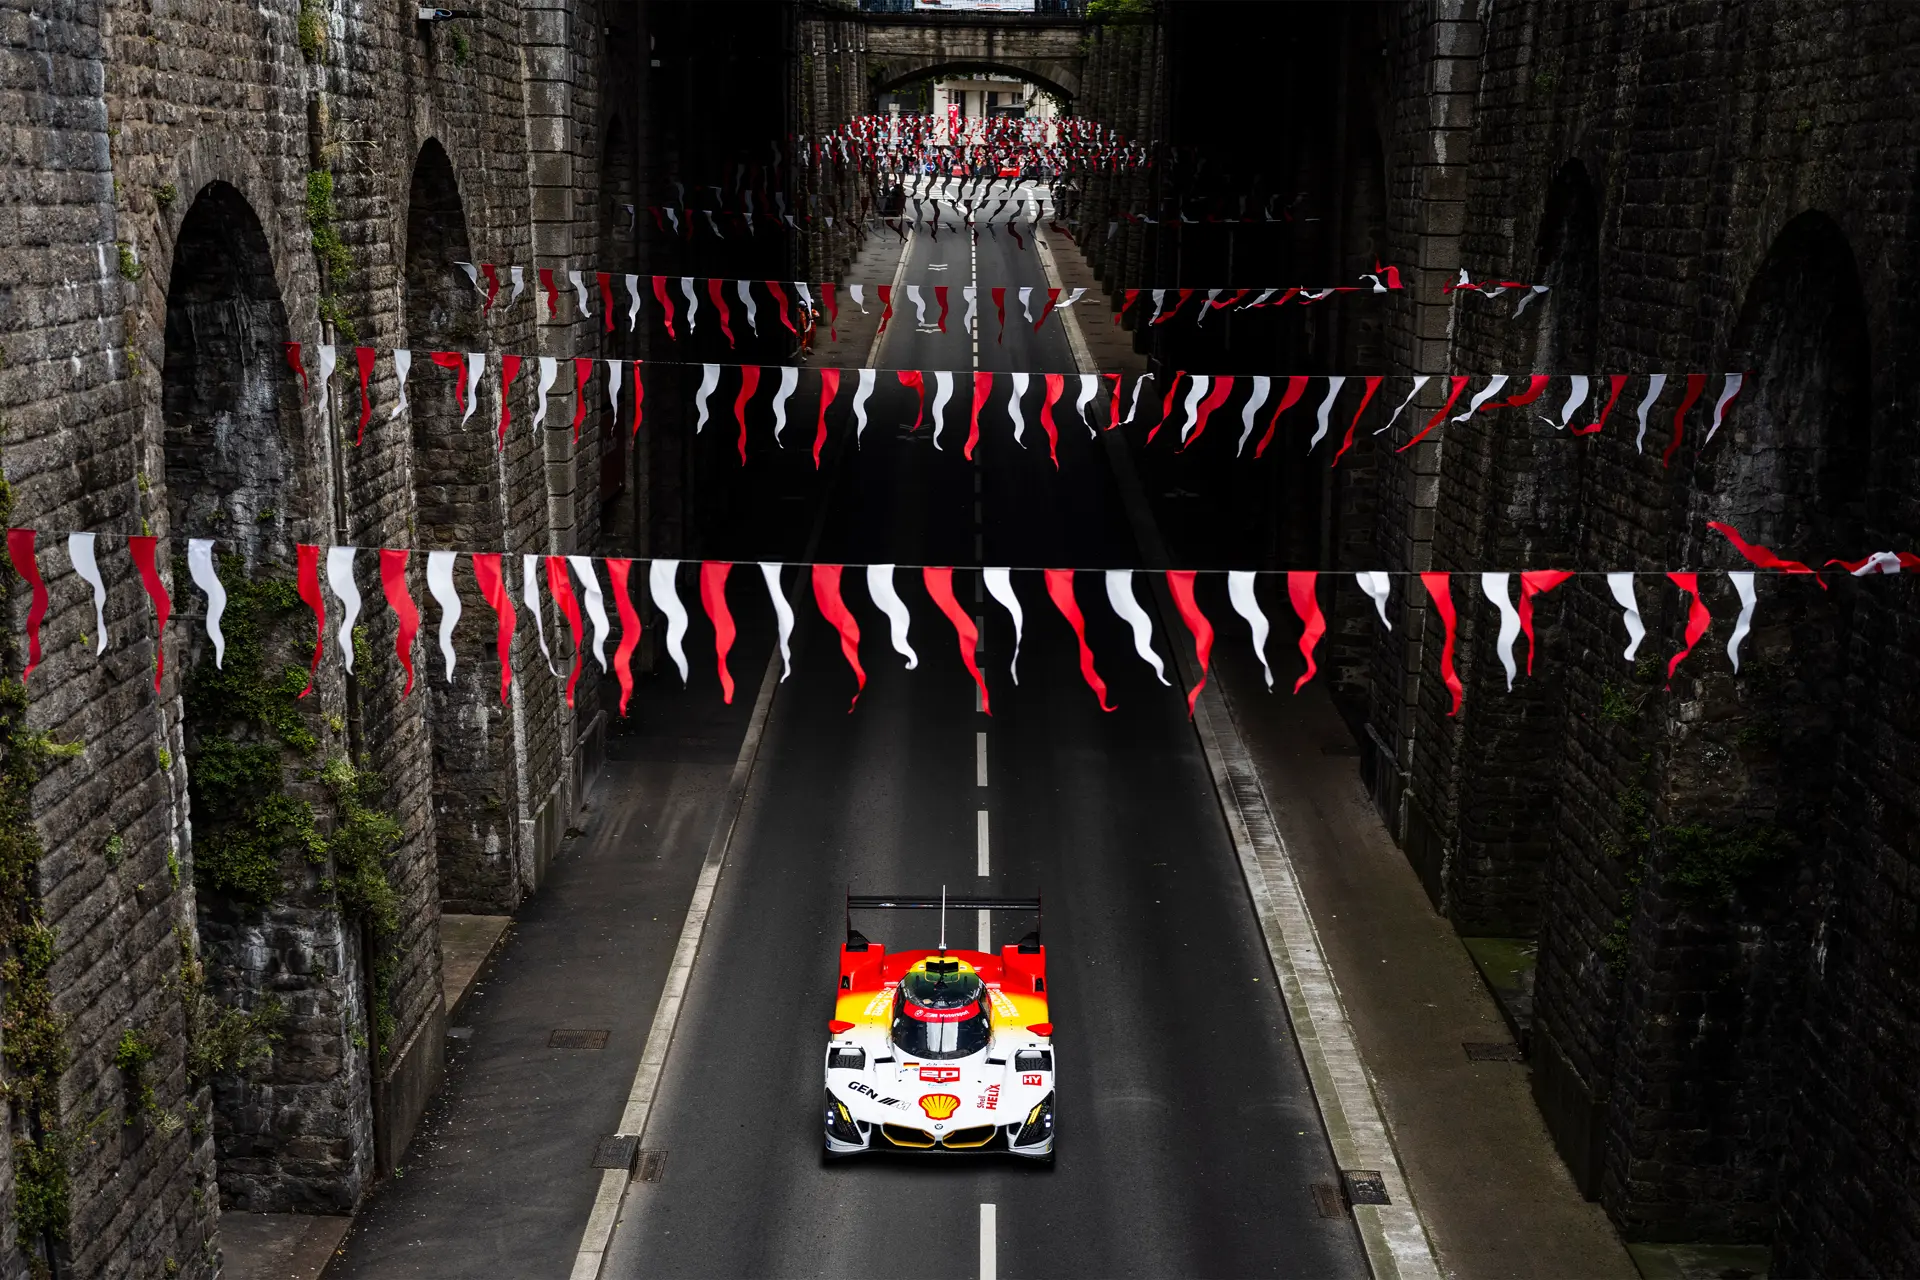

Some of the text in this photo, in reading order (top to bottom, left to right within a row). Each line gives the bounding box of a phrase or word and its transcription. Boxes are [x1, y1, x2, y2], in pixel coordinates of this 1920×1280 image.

[921, 1070, 959, 1078] 20
[1023, 1076, 1041, 1085] HY
[848, 1081, 878, 1100] GEN
[985, 1084, 1001, 1110] HELIX
[977, 1095, 986, 1109] Shell
